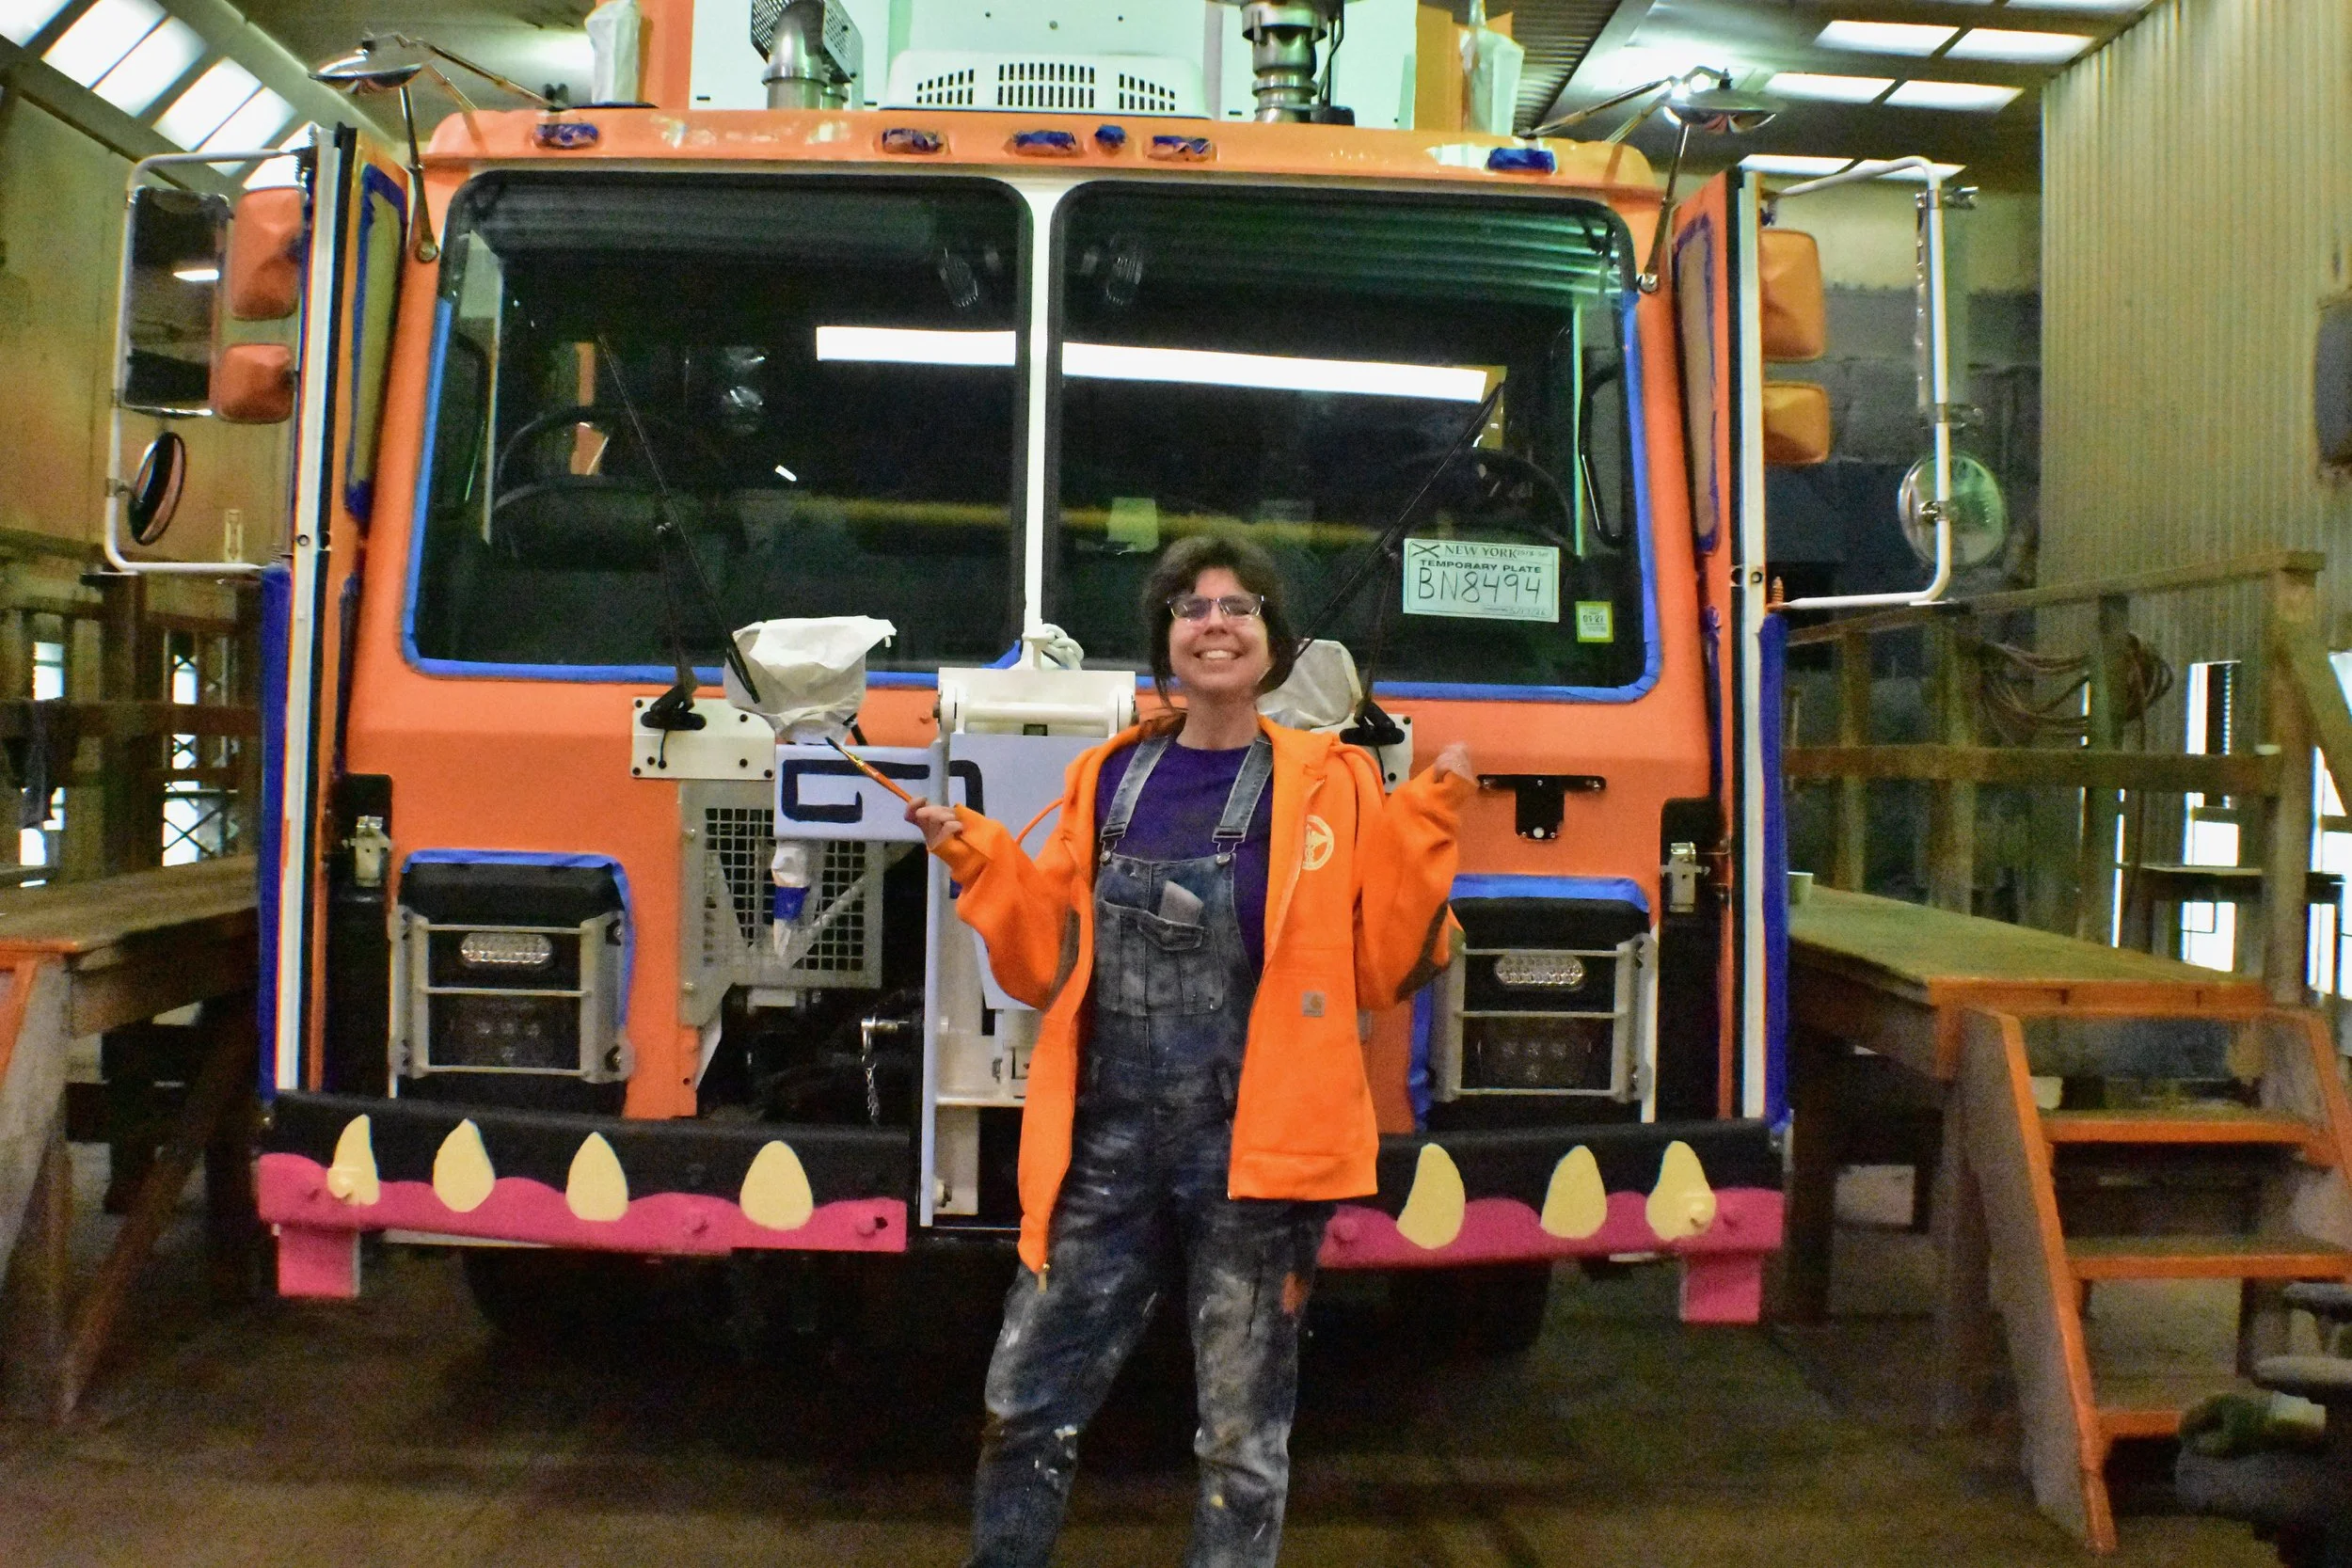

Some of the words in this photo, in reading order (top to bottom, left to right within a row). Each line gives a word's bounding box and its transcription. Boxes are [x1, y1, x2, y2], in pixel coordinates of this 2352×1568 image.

[1445, 545, 1477, 556] NEW
[1483, 547, 1517, 559] YORK
[1421, 560, 1498, 571] TEMPORARY
[1503, 565, 1542, 574] PLATE
[1418, 567, 1541, 604] BN8494
